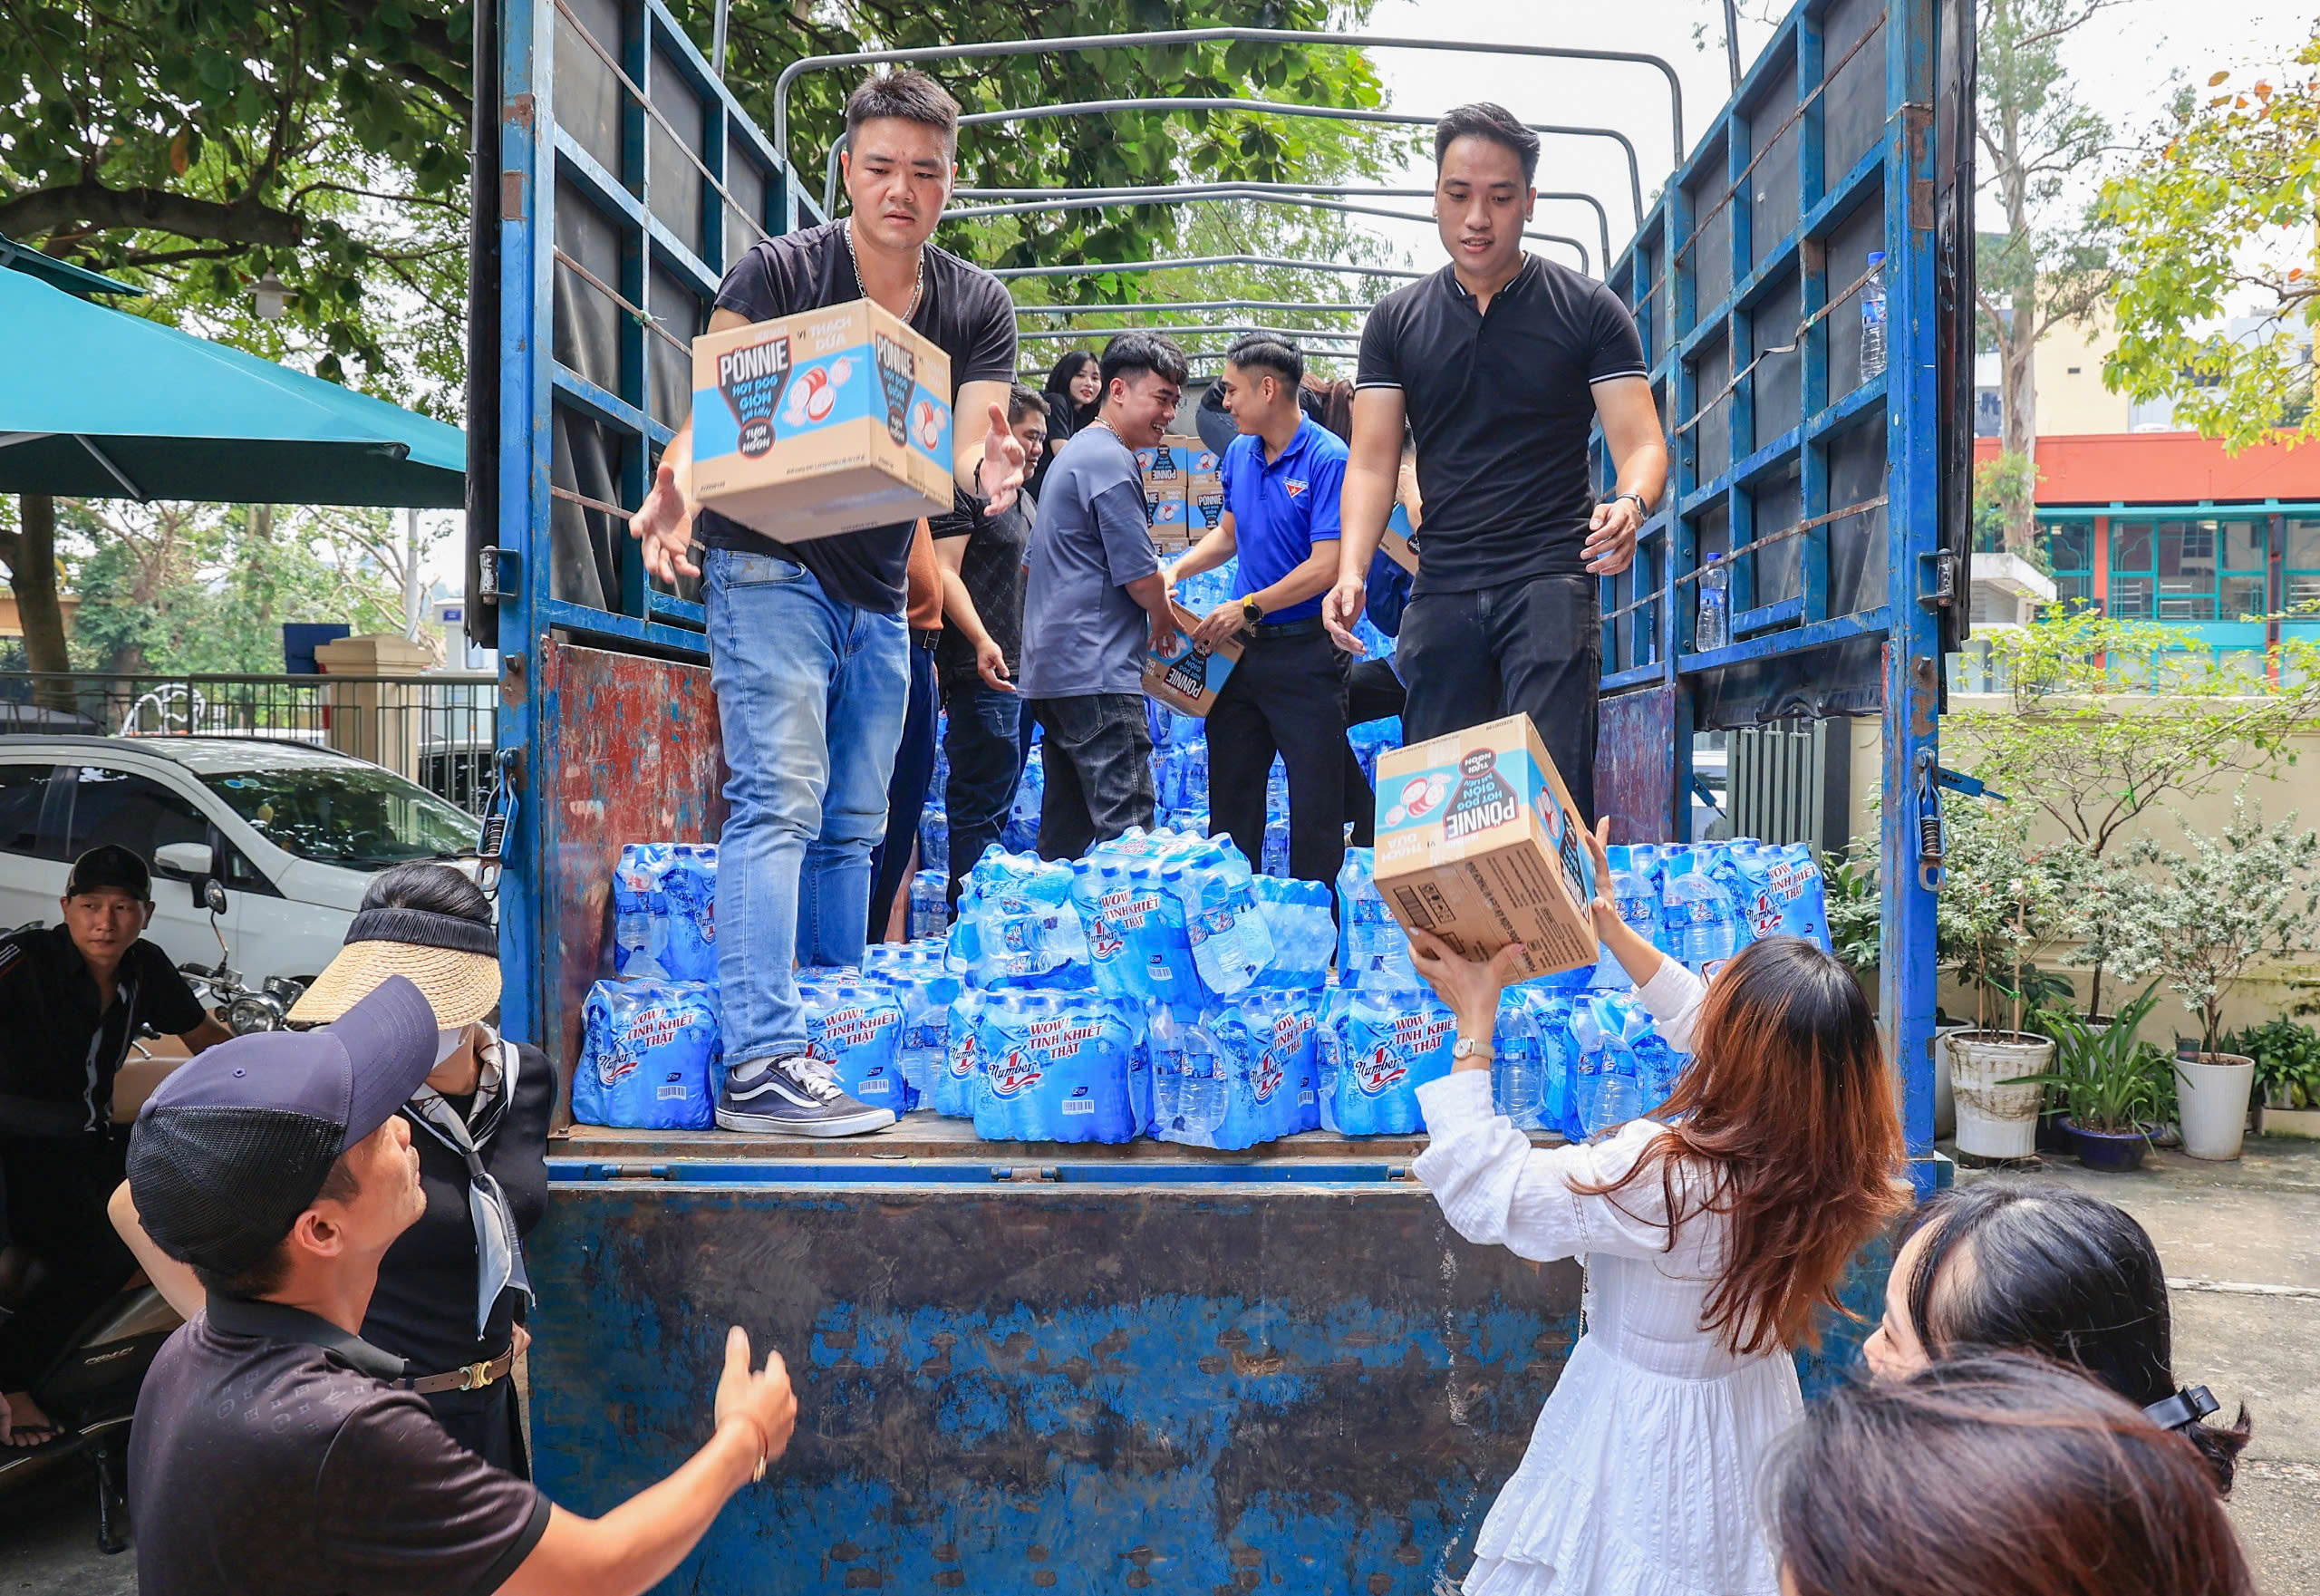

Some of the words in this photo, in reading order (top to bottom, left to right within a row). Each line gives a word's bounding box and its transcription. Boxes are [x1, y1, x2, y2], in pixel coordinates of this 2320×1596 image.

[755, 373, 778, 392] DOG
[1464, 752, 1492, 766] NGON
[1456, 796, 1480, 811] DOG
[1482, 790, 1503, 804] HOT
[1105, 907, 1128, 920] TINH
[1746, 901, 1778, 924] Number
[1084, 927, 1116, 944] Number
[627, 1023, 652, 1040] TINH
[658, 1011, 695, 1030] KHIẾT
[826, 1009, 863, 1026] WOW!
[826, 1022, 855, 1039] TINH
[859, 1011, 895, 1029] KHIẾT
[1396, 1012, 1430, 1030] WOW!
[1030, 1018, 1068, 1035] WOW!
[1396, 1029, 1421, 1044] TINH
[1427, 1017, 1457, 1035] KHIẾ
[645, 1030, 674, 1047] THẬT
[846, 1030, 875, 1044] THẬT
[1030, 1034, 1058, 1049] TINH
[1063, 1023, 1102, 1041] KHIẾT
[1413, 1035, 1443, 1053] THẬT
[950, 1044, 975, 1061] Numb
[1050, 1042, 1080, 1059] THẬT
[989, 1058, 1037, 1080] Number
[1251, 1059, 1280, 1087] Number
[1356, 1054, 1401, 1079] Number
